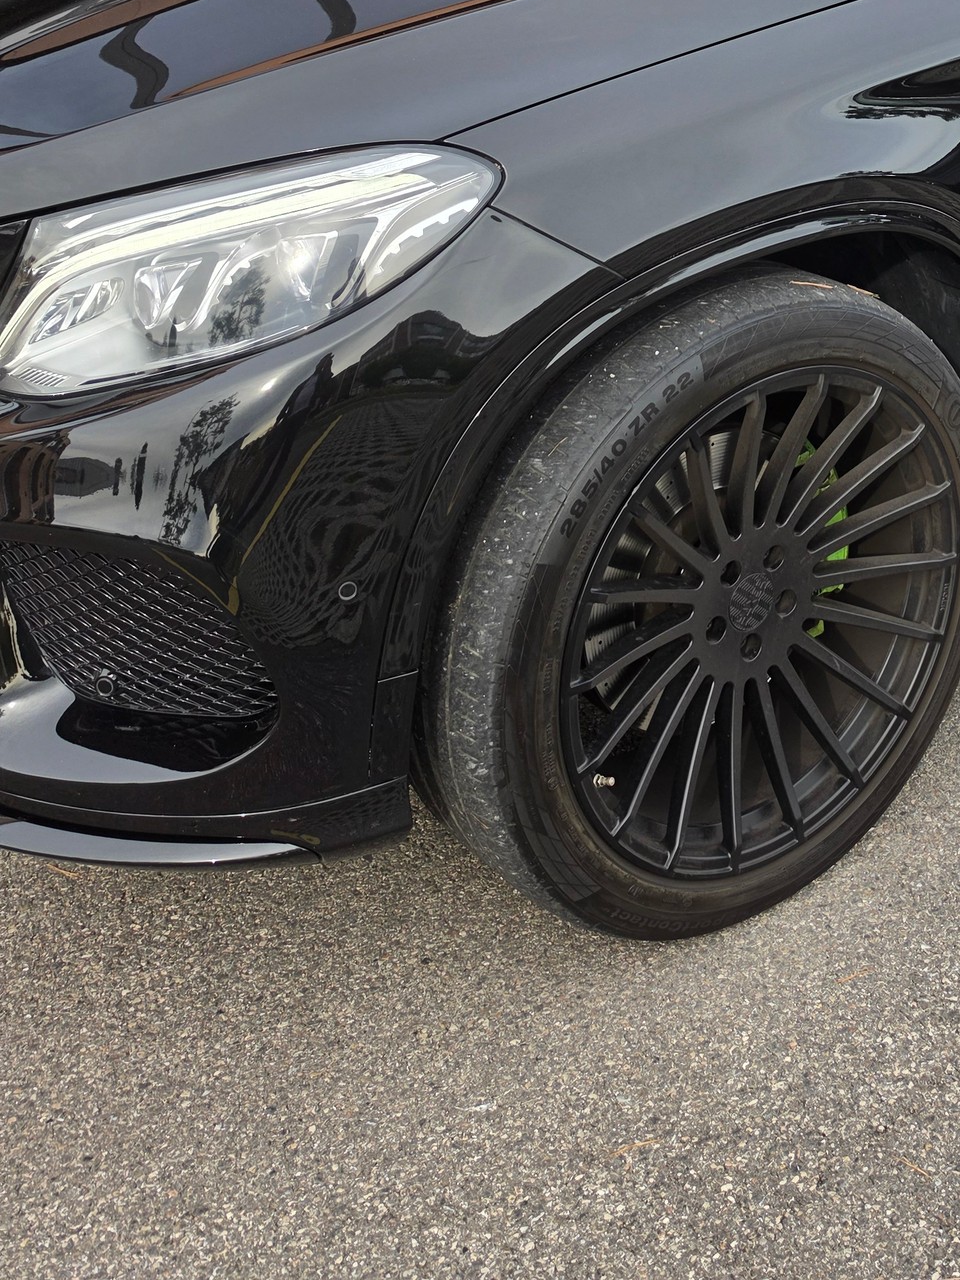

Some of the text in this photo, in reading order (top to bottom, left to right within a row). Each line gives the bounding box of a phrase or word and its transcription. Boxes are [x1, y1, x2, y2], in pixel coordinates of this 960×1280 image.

[559, 371, 696, 539] 285/40 ZR 22
